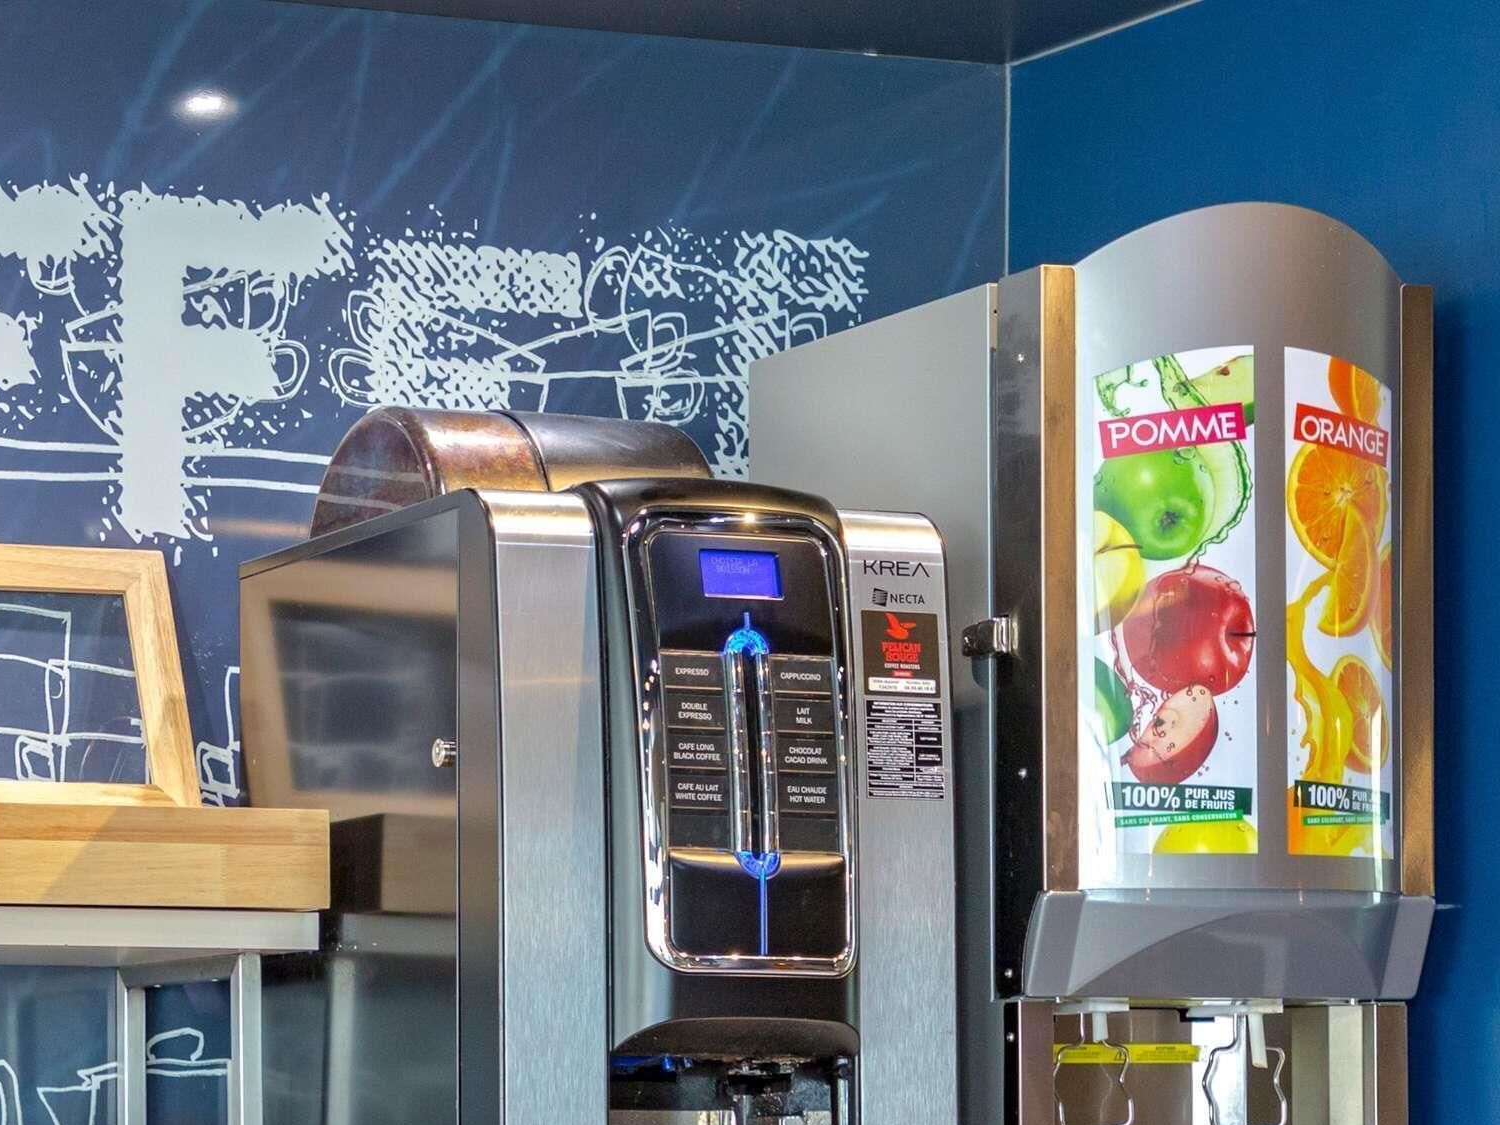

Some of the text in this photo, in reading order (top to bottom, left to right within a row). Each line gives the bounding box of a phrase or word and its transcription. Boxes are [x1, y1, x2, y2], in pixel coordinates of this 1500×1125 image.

[1107, 411, 1237, 449] POMME
[1300, 414, 1386, 457] ORANGE
[863, 560, 930, 578] KREA
[890, 593, 925, 604] NECTA
[881, 642, 921, 653] PELICAN
[885, 652, 919, 662] ROUGE
[675, 667, 709, 676] EXPRESSO
[780, 672, 821, 681] CAPPUCCINO
[681, 702, 708, 711] DOUBLE
[796, 707, 810, 715] LAIT
[678, 711, 713, 721] EXPRESSO
[795, 716, 812, 724] MILK
[678, 742, 715, 752] CAFE LONG
[788, 746, 822, 755] CHOCOLAT
[673, 751, 721, 761] BLACK COFFEE
[785, 755, 828, 765] CACAO DRINK
[677, 782, 719, 792] CAFE AU LAIT
[787, 785, 828, 795] EAU CHAUDE
[675, 792, 723, 802] WHITE COFFEE
[789, 795, 826, 804] HOT WATER
[1121, 786, 1181, 809] 100%
[1185, 788, 1235, 801] PUR JUS
[1308, 785, 1350, 810] 100%
[1352, 790, 1368, 801] PUR
[1185, 799, 1235, 811] DE FRUITS
[1352, 802, 1361, 810] DE
